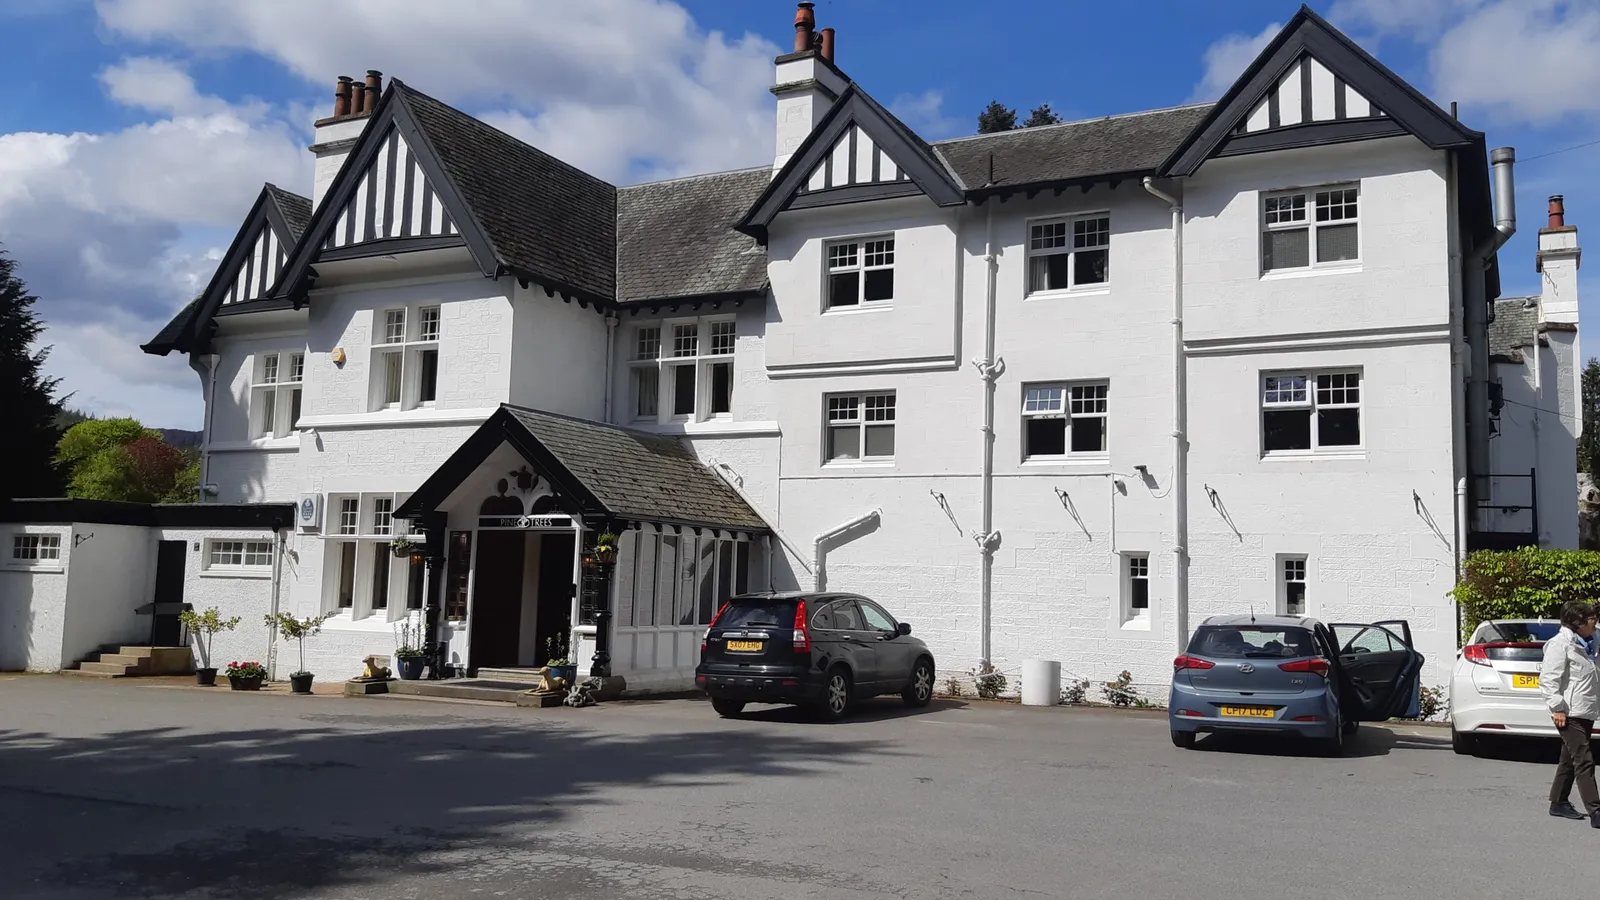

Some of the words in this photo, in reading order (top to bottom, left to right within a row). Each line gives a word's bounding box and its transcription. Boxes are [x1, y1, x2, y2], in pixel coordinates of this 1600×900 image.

[500, 518, 517, 527] PINE
[531, 517, 552, 527] TREES
[1226, 705, 1247, 715] CP17
